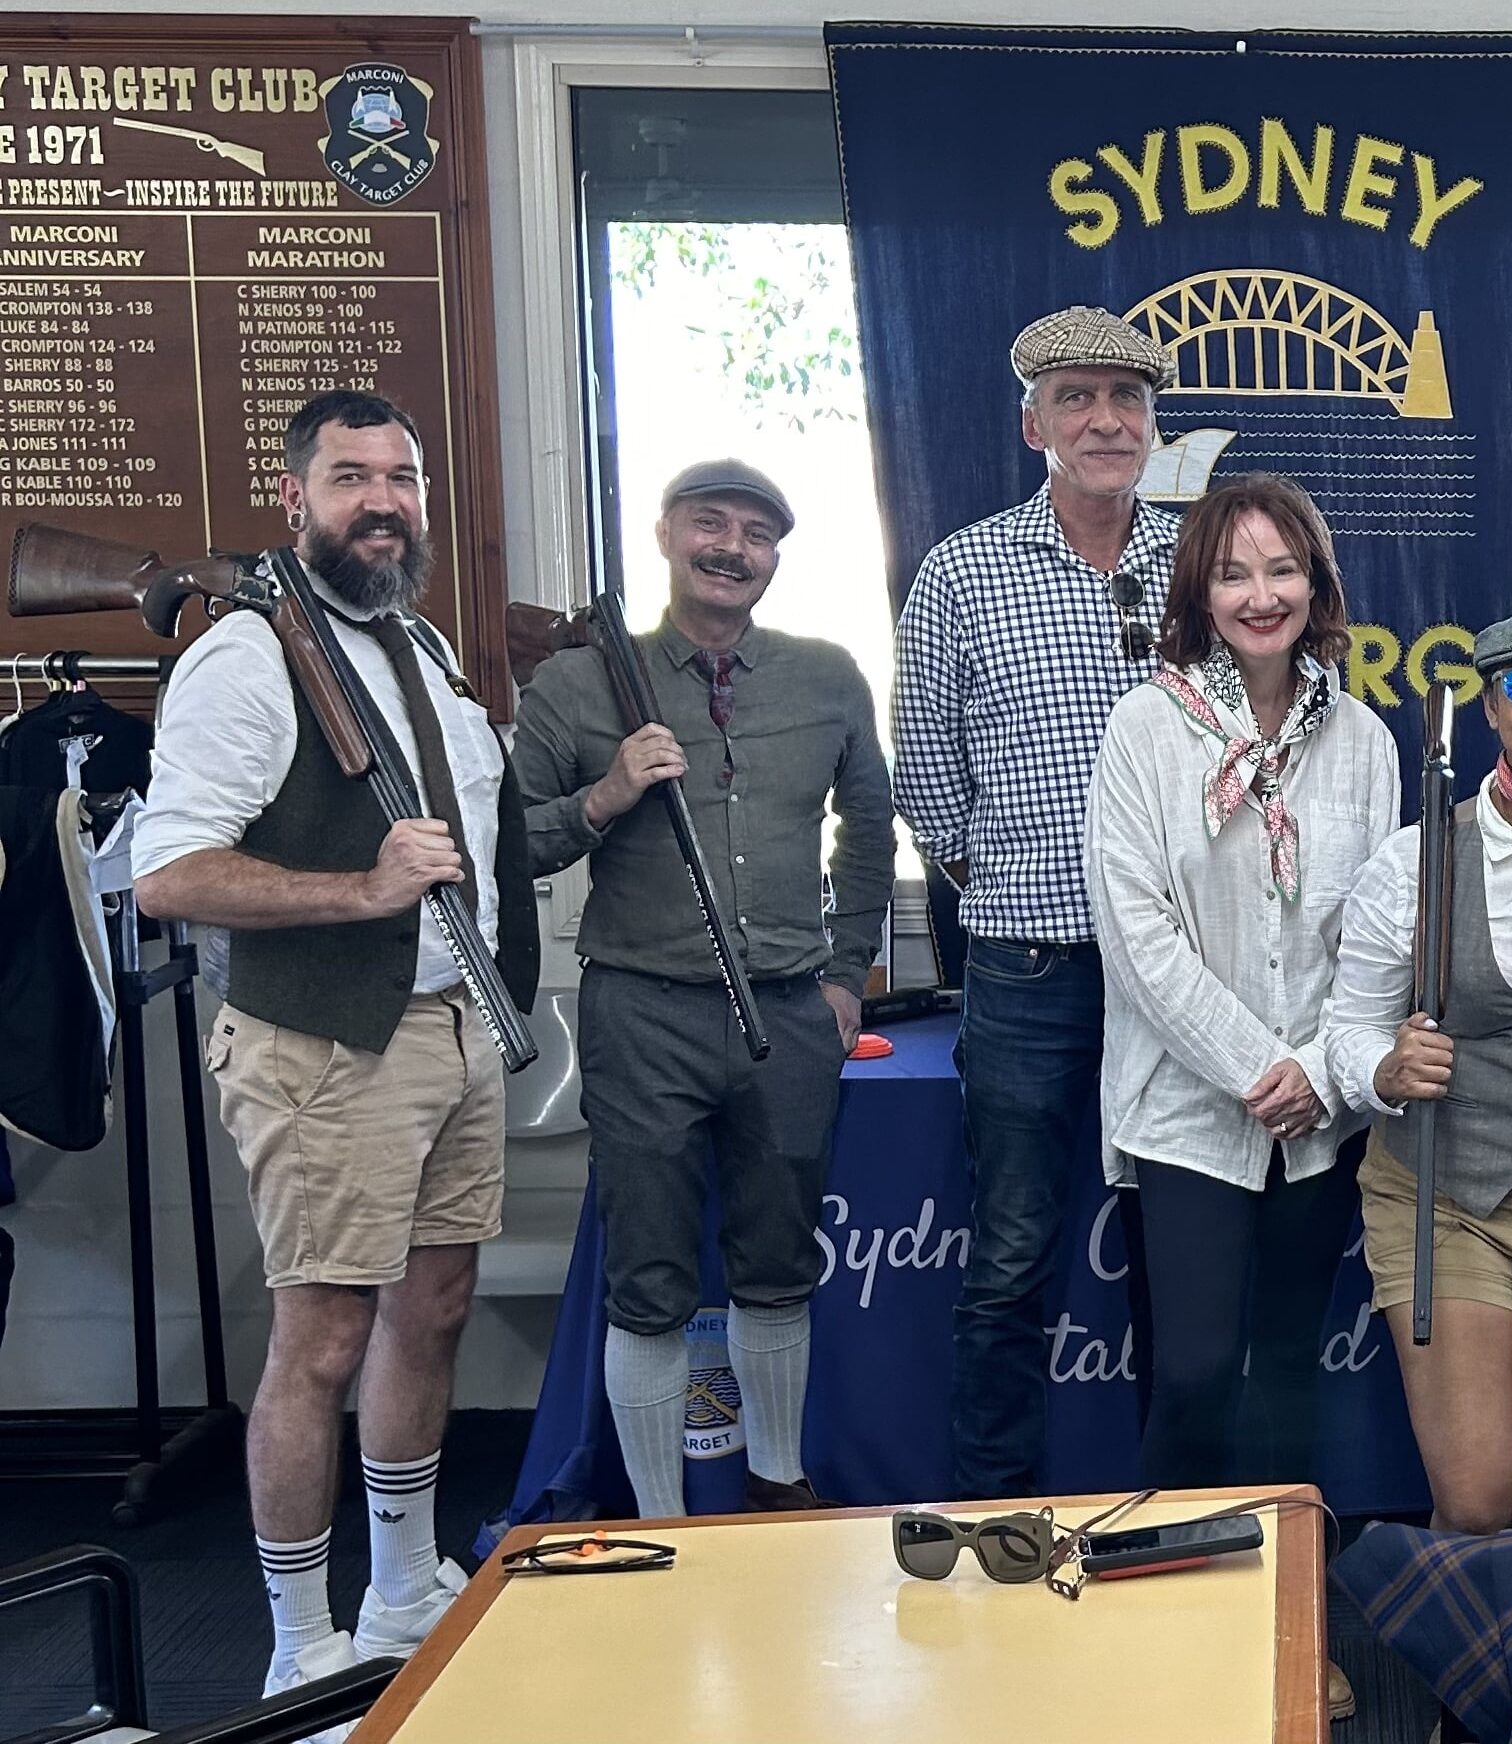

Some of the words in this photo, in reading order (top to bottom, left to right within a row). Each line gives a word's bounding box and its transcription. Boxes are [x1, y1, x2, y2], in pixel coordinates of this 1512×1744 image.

[347, 69, 404, 84] MARCONI
[23, 66, 195, 111] TARGET
[211, 68, 320, 112] CLUB
[27, 126, 103, 164] 1971
[331, 160, 359, 185] CLAY
[360, 181, 403, 201] TARGET
[404, 159, 428, 184] CLUB
[1049, 116, 1485, 249] SYDNEY
[215, 181, 255, 206] THE
[260, 181, 337, 207] FUTURE
[11, 226, 117, 242] MARCONI
[259, 228, 370, 244] MARCONI
[0, 250, 145, 266] NNIVERSARY
[248, 251, 384, 267] MARATHON
[0, 283, 48, 296] SALEM
[53, 283, 70, 296] 54
[84, 284, 101, 296] 54
[238, 285, 247, 298] C
[252, 285, 306, 298] SHERRY
[311, 286, 336, 299] 100
[351, 285, 376, 298] 100
[0, 302, 82, 315] CROMPTON
[87, 302, 113, 315] 138
[127, 302, 152, 314] 138
[239, 303, 248, 316] N
[254, 303, 302, 317] XENOS
[306, 304, 323, 317] 99
[338, 304, 363, 317] 100
[0, 320, 36, 333] LUKE
[41, 321, 58, 333] 84
[72, 321, 89, 333] 84
[239, 321, 253, 334] M
[258, 321, 325, 334] PATMORE
[330, 321, 355, 334] 114
[370, 321, 394, 334] 115
[2, 339, 84, 352] CROMPTON
[89, 340, 115, 352] 124
[129, 340, 155, 352] 124
[241, 340, 246, 353] J
[251, 340, 332, 353] CROMPTON
[338, 340, 361, 353] 121
[377, 340, 401, 353] 122
[5, 358, 60, 372] SHERRY
[65, 359, 82, 372] 88
[96, 359, 113, 371] 88
[241, 359, 250, 372] C
[255, 359, 309, 372] SHERRY
[314, 359, 338, 372] 125
[353, 359, 377, 372] 125
[4, 379, 61, 392] BARROS
[66, 379, 83, 392] 50
[97, 379, 114, 392] 50
[242, 378, 252, 391] N
[257, 378, 305, 391] XENOS
[310, 378, 335, 391] 123
[349, 377, 374, 390] 124
[9, 400, 64, 413] SHERRY
[68, 400, 85, 413] 96
[99, 400, 116, 413] 96
[10, 419, 65, 431] SHERRY
[70, 419, 95, 431] 172
[110, 418, 135, 431] 172
[12, 437, 57, 450] JONES
[63, 438, 86, 450] 111
[102, 437, 125, 450] 111
[0, 458, 10, 470] G
[17, 458, 71, 470] KABLE
[77, 458, 108, 471] 109
[125, 458, 155, 471] 109
[2, 476, 11, 489] G
[17, 476, 61, 489] KABLE
[67, 476, 92, 489] 110
[106, 476, 131, 488] 110
[2, 493, 11, 506] R
[16, 493, 113, 506] BOU-MOUSSA
[118, 493, 142, 506] 120
[157, 494, 182, 506] 120
[813, 1194, 971, 1308] Sydn
[686, 1319, 728, 1333] DNEY
[684, 1432, 731, 1450] ARGET
